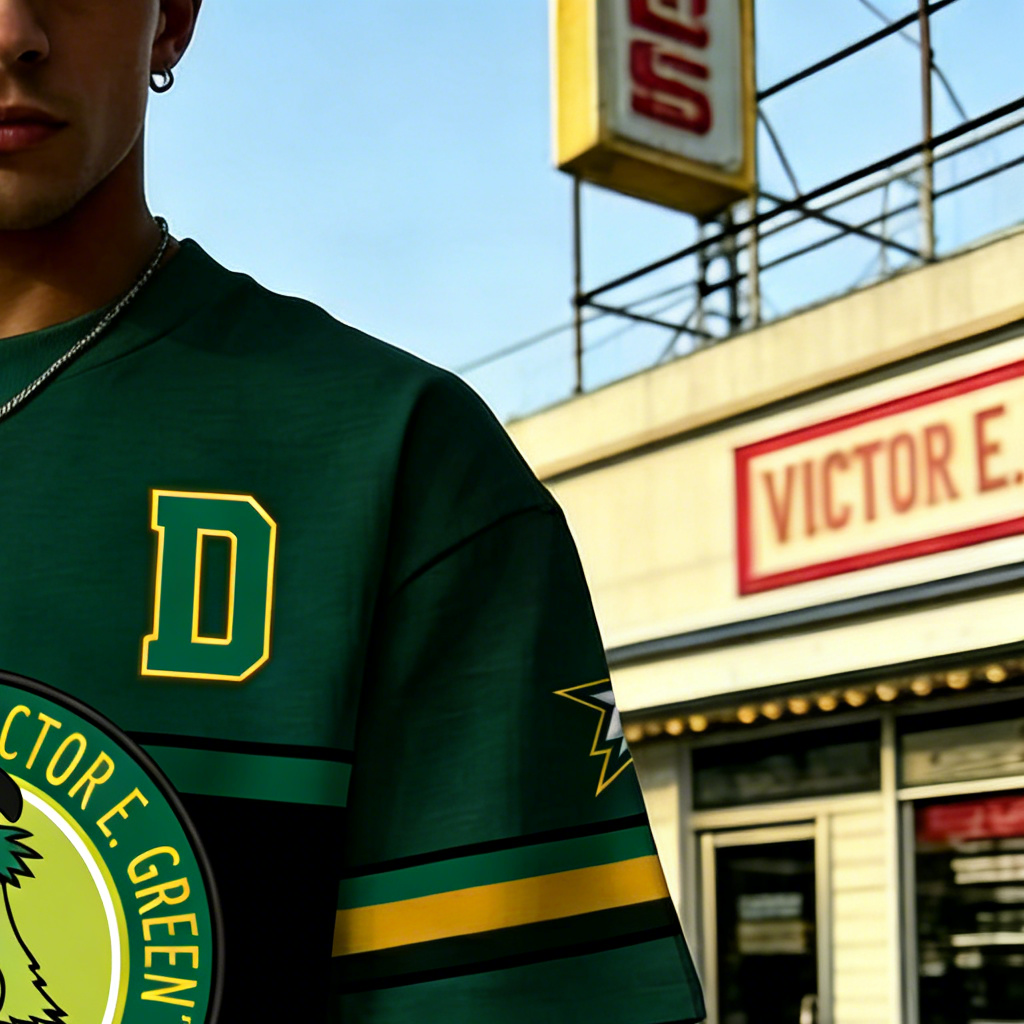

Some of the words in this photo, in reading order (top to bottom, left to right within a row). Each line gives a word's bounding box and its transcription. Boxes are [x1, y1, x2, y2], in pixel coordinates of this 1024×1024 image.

[762, 422, 960, 544] VICTOR
[974, 404, 1024, 493] E.
[141, 489, 277, 682] D
[96, 787, 149, 848] E.
[127, 846, 199, 1008] GREEN
